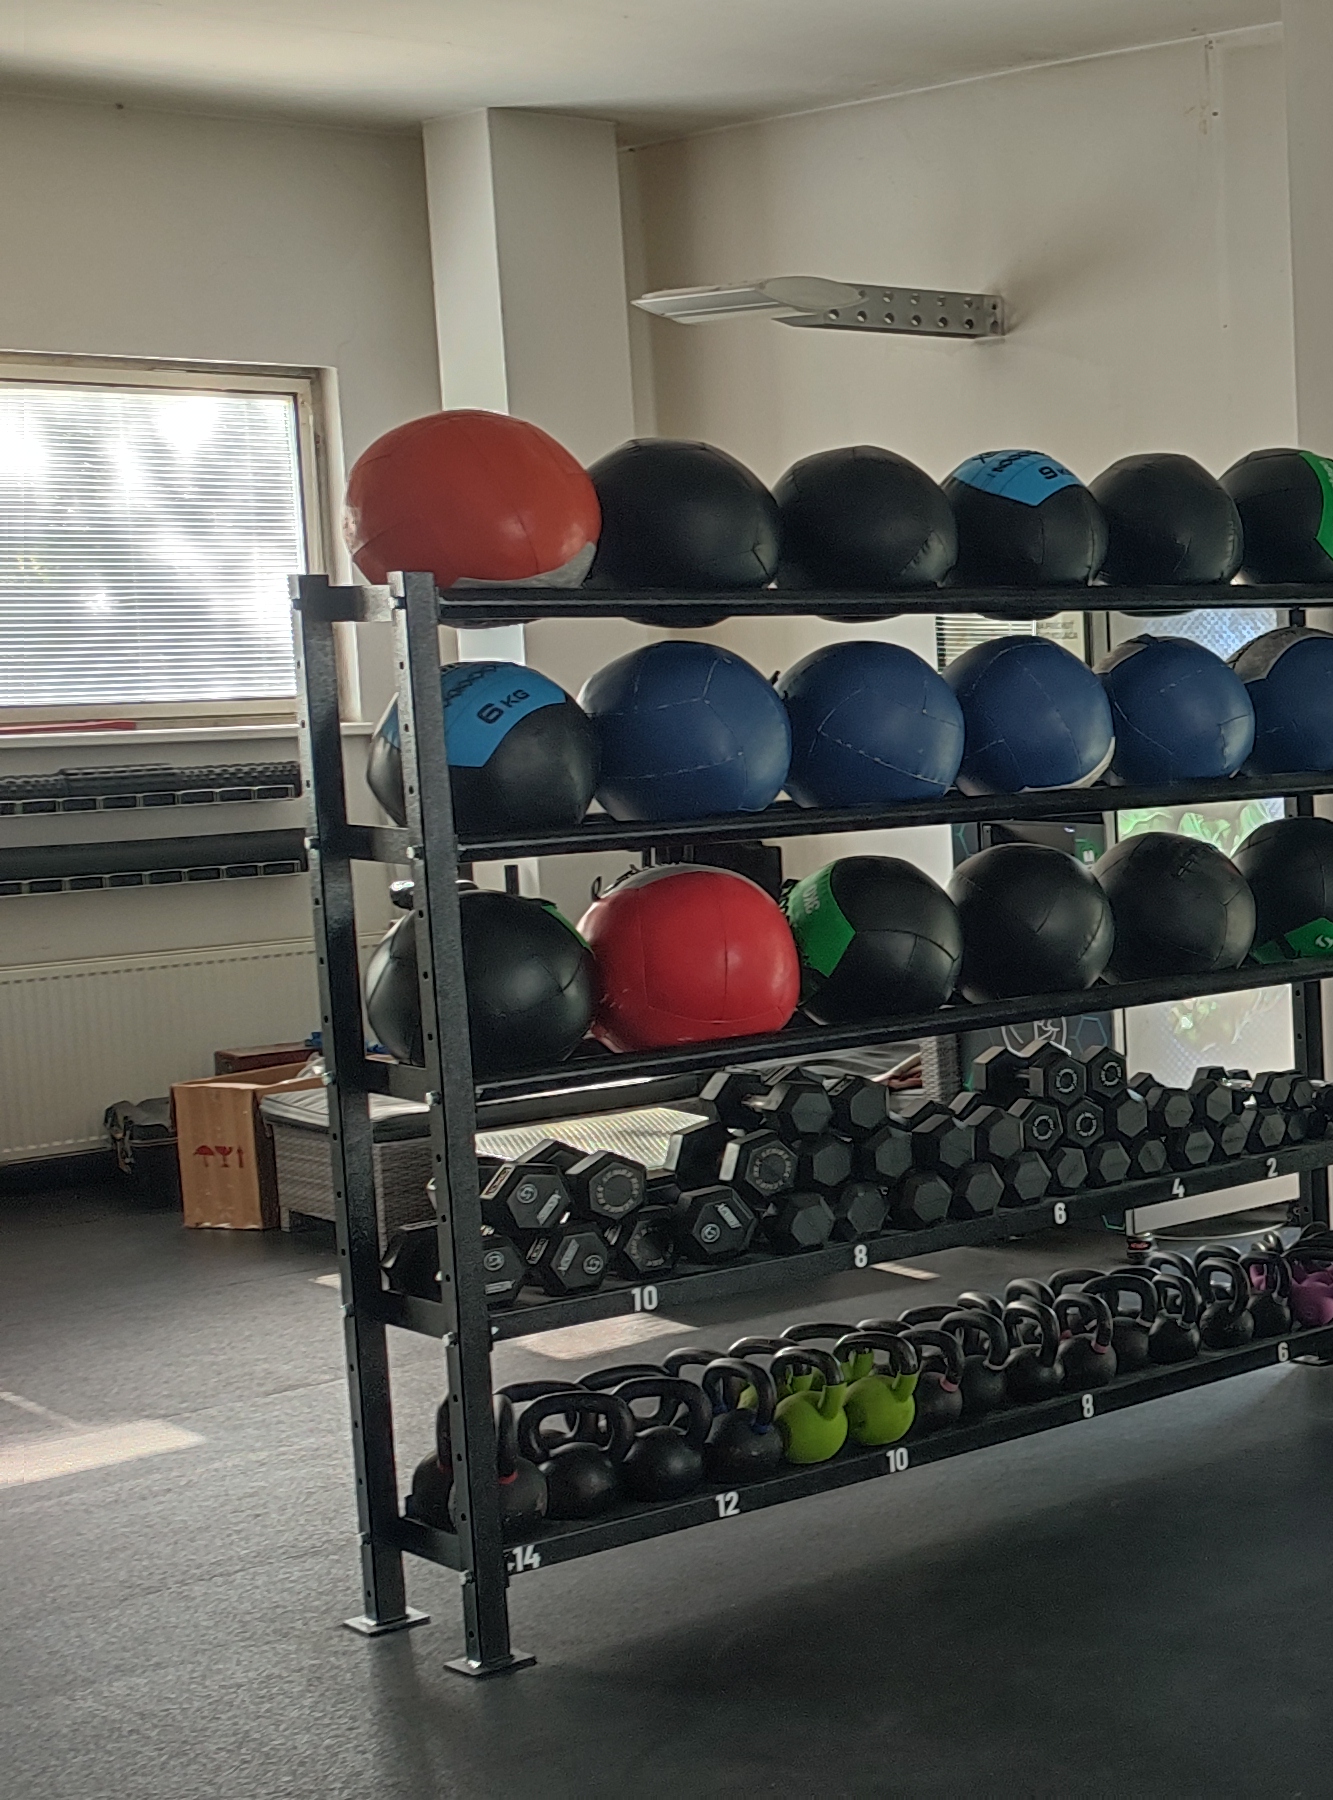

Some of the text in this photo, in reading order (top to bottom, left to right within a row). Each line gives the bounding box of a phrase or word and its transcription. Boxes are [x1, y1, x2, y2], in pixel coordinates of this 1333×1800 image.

[477, 689, 530, 724] 6 KG
[1266, 1158, 1278, 1178] 2
[1171, 1178, 1185, 1198] 4
[1054, 1202, 1067, 1224] 6
[854, 1244, 868, 1268] 8
[631, 1285, 658, 1312] 10
[1278, 1341, 1289, 1362] 6
[1081, 1393, 1094, 1418] 8
[886, 1447, 909, 1473] 10
[715, 1491, 740, 1518] 12
